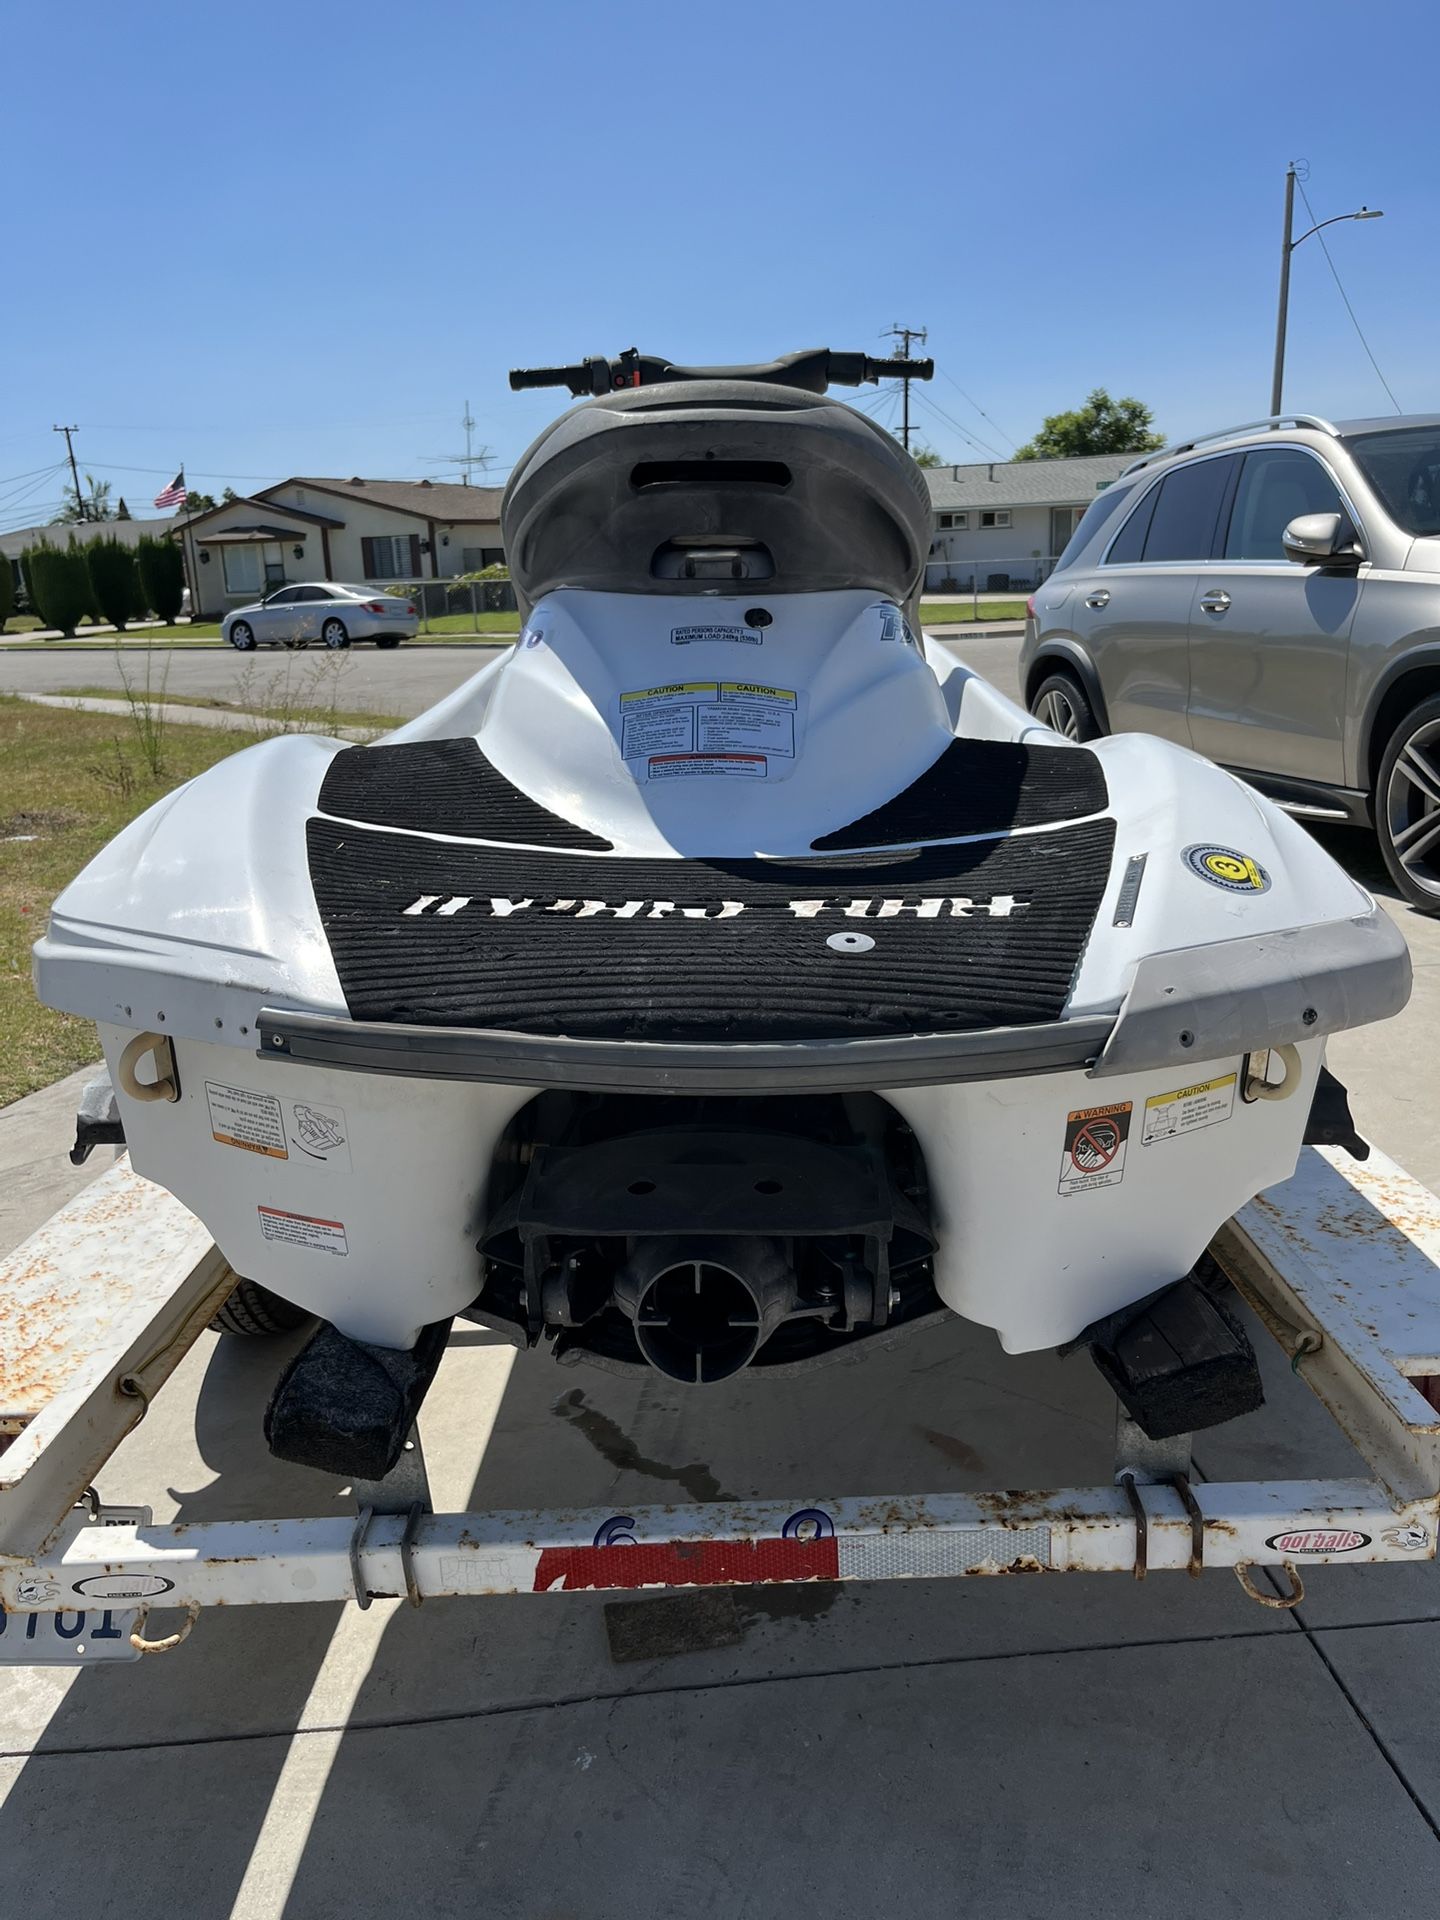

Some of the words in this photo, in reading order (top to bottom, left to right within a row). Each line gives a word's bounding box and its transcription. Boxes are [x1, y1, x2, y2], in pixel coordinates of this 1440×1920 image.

[648, 685, 684, 696] CAUTION
[736, 685, 776, 695] CAUTION
[1214, 861, 1241, 873] 3
[1176, 1084, 1211, 1099] CAUTION
[1084, 1103, 1126, 1118] WARNING
[1279, 1533, 1311, 1551] got
[1312, 1532, 1359, 1548] balls
